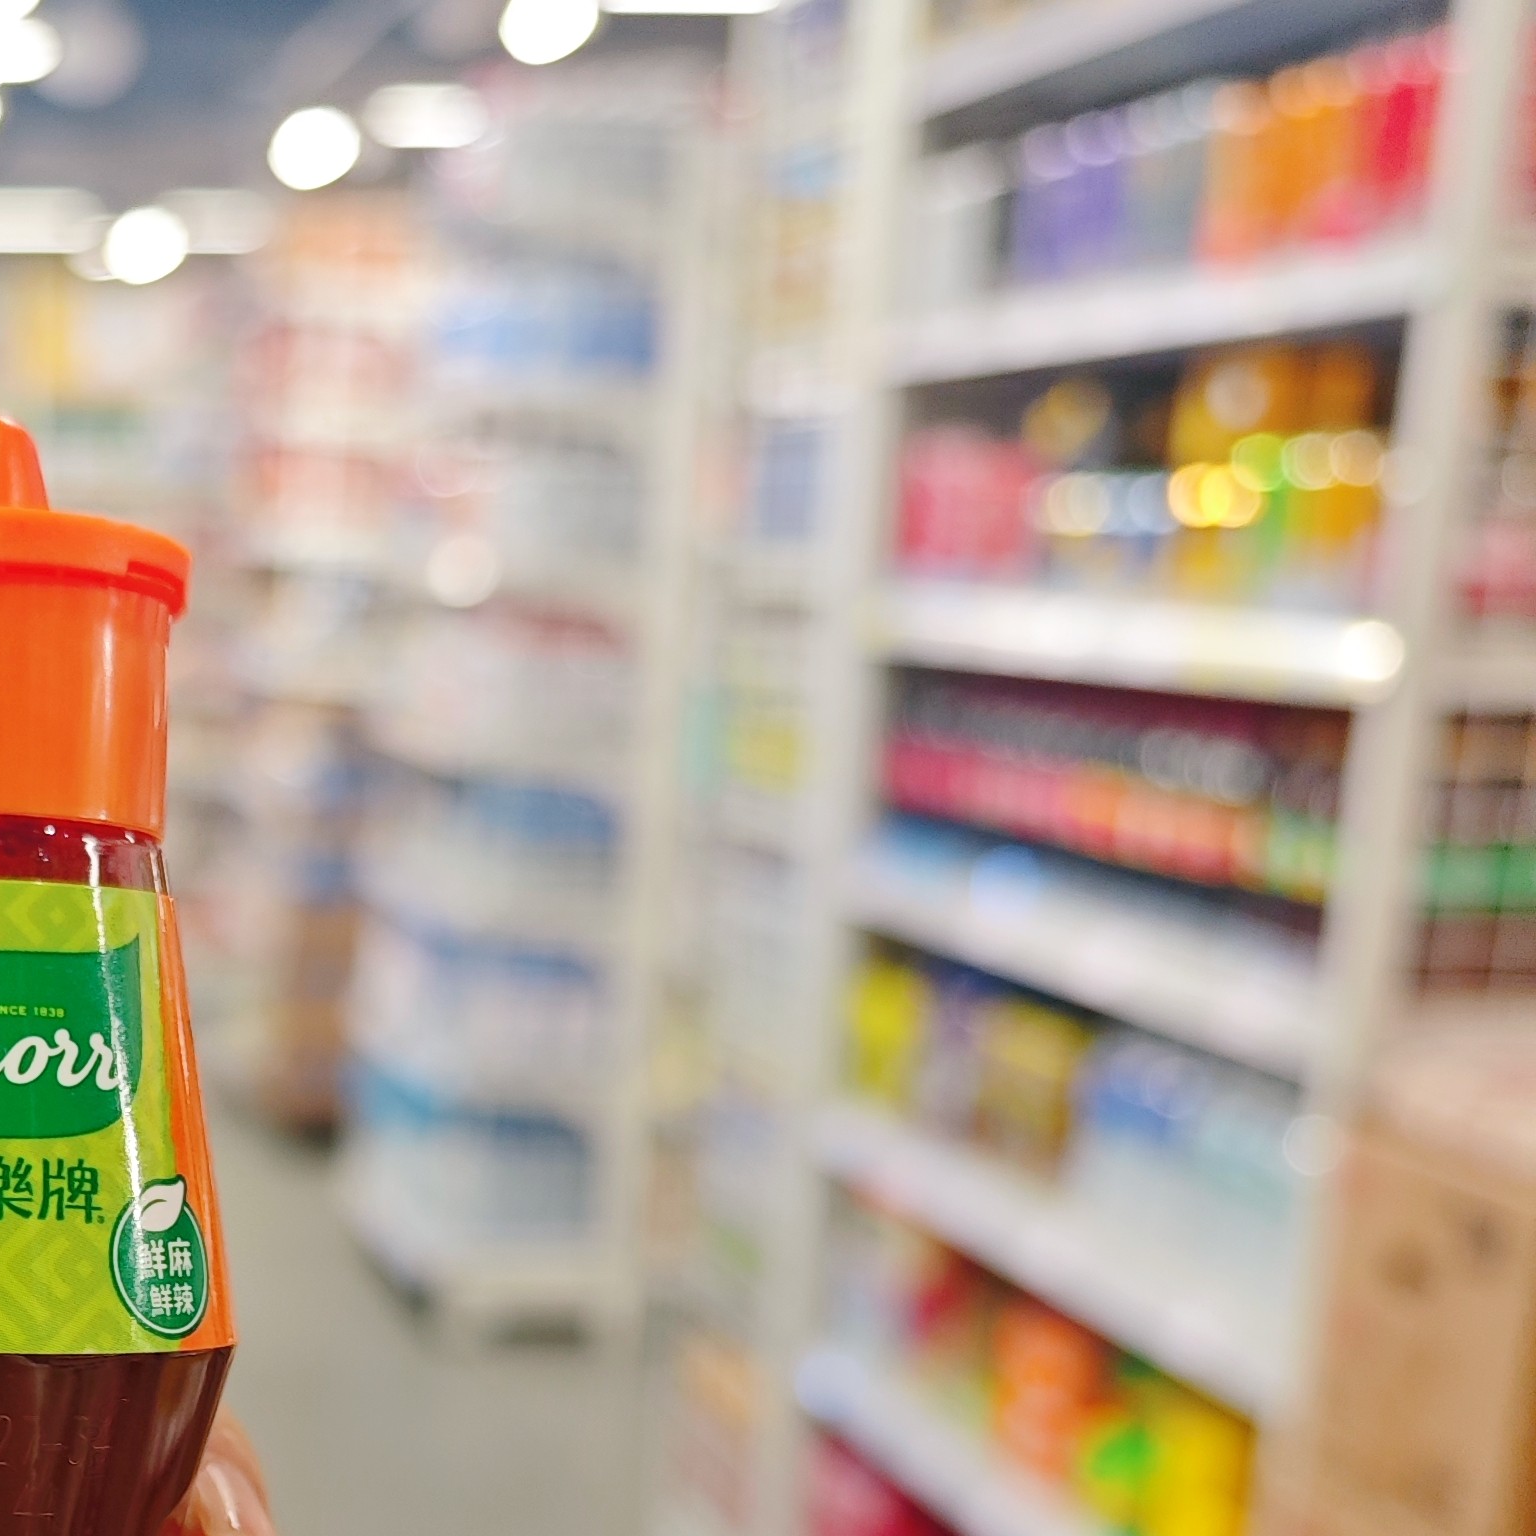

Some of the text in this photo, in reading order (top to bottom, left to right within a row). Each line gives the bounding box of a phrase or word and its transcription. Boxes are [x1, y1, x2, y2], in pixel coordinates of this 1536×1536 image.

[34, 1006, 66, 1018] 1838
[140, 1237, 194, 1279] 鮮麻
[149, 1281, 195, 1317] 鮮辣
